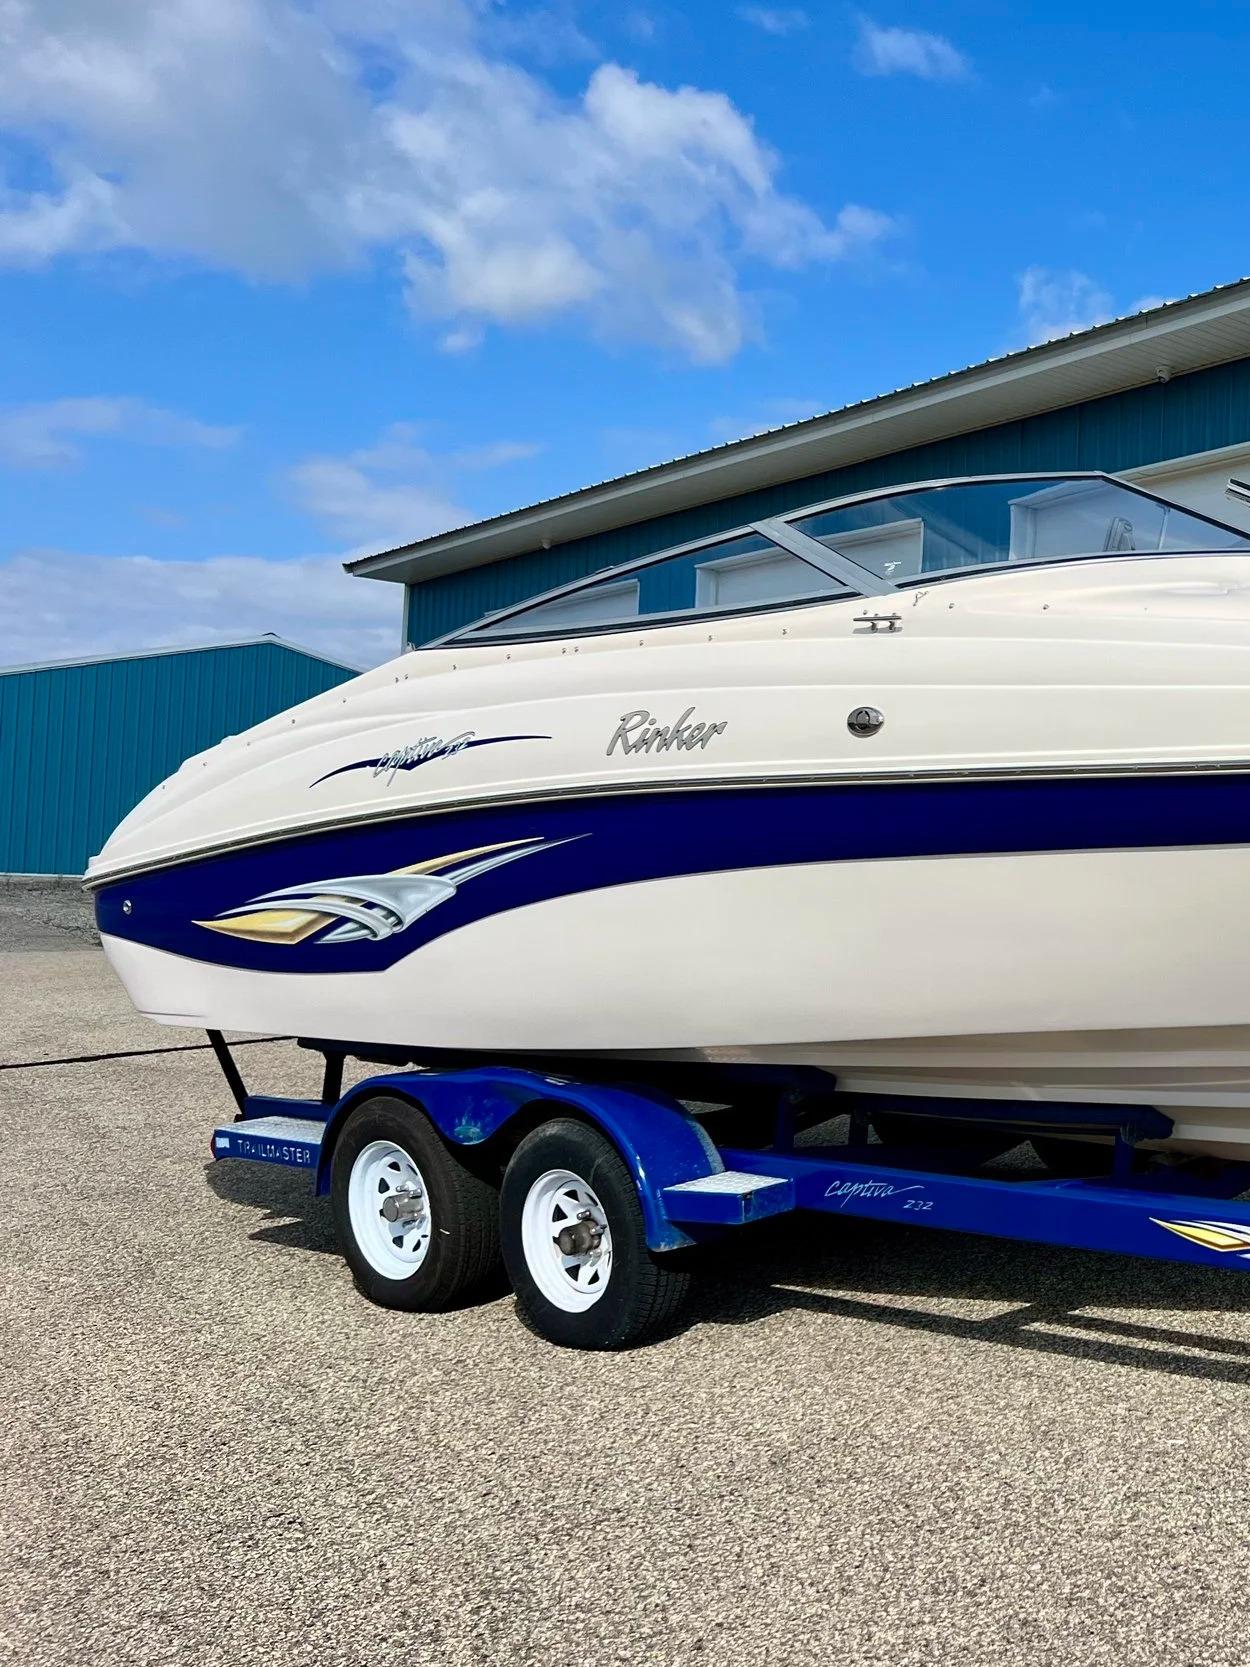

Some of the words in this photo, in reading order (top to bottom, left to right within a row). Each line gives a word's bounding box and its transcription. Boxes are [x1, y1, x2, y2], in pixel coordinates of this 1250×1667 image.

[606, 706, 728, 756] Rinker
[237, 1139, 311, 1164] TRAILMASTER
[902, 1200, 934, 1211] 232
